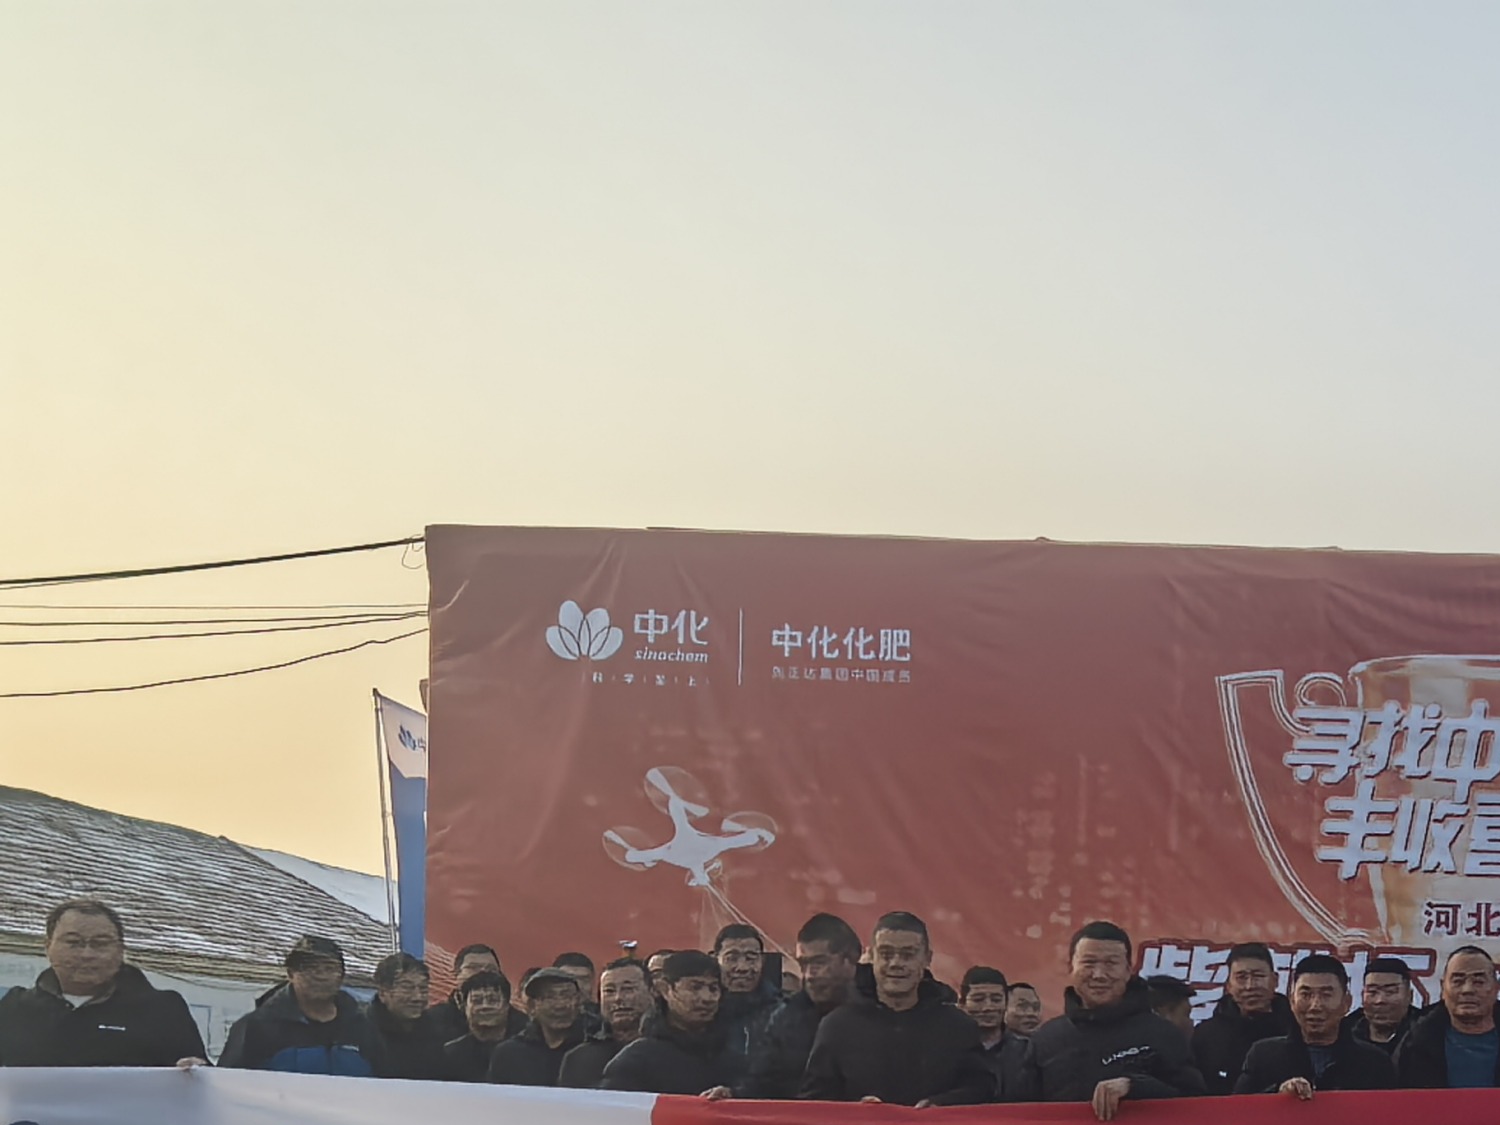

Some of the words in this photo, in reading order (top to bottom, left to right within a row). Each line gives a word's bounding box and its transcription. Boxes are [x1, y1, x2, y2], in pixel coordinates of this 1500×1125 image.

[633, 609, 710, 646] 中化
[771, 623, 912, 662] 中化化肥
[633, 645, 710, 664] sinochem
